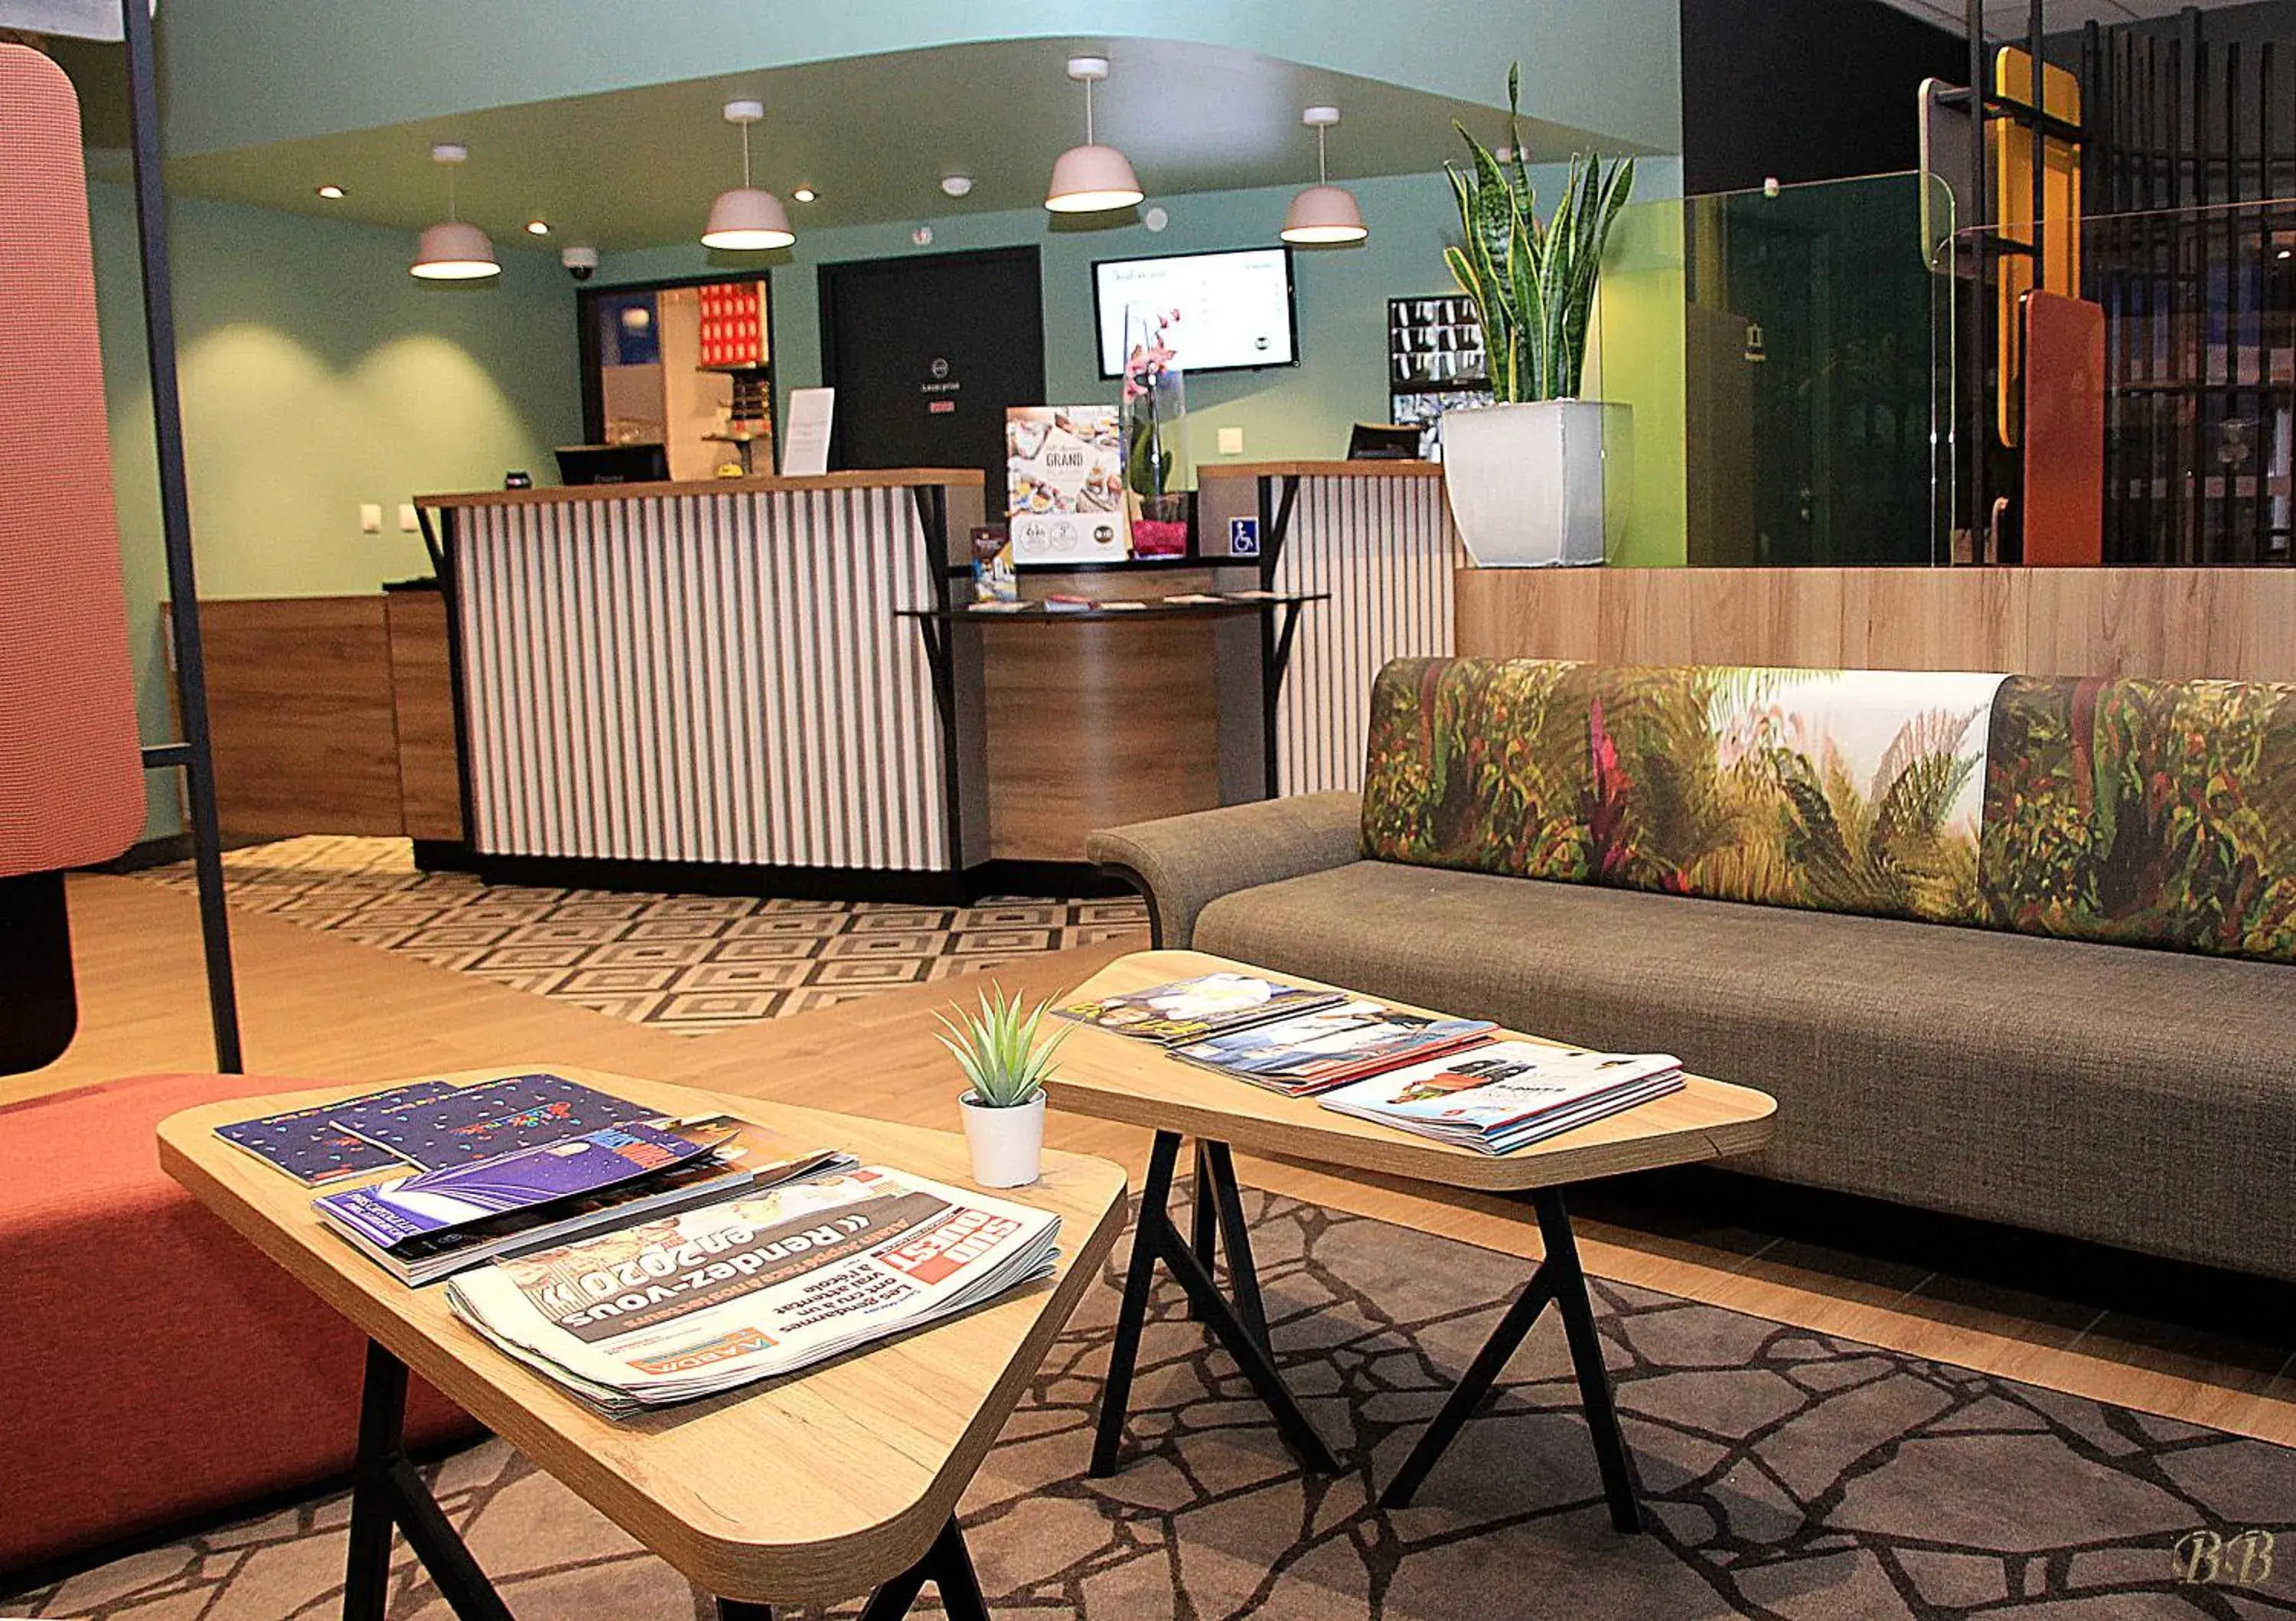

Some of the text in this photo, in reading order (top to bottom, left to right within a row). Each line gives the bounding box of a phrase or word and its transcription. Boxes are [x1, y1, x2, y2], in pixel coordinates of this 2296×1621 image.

[1046, 452, 1084, 467] GRAND
[694, 1225, 756, 1254] en
[882, 1210, 991, 1272] OUEST
[943, 1218, 1020, 1264] SUD
[561, 1223, 847, 1328] Rendez-vous
[578, 1241, 708, 1300] 2020
[858, 1263, 874, 1272] à
[772, 1270, 885, 1315] vrai attentat
[779, 1283, 913, 1332] Les gendarmes
[797, 1277, 898, 1316] ont cru à un
